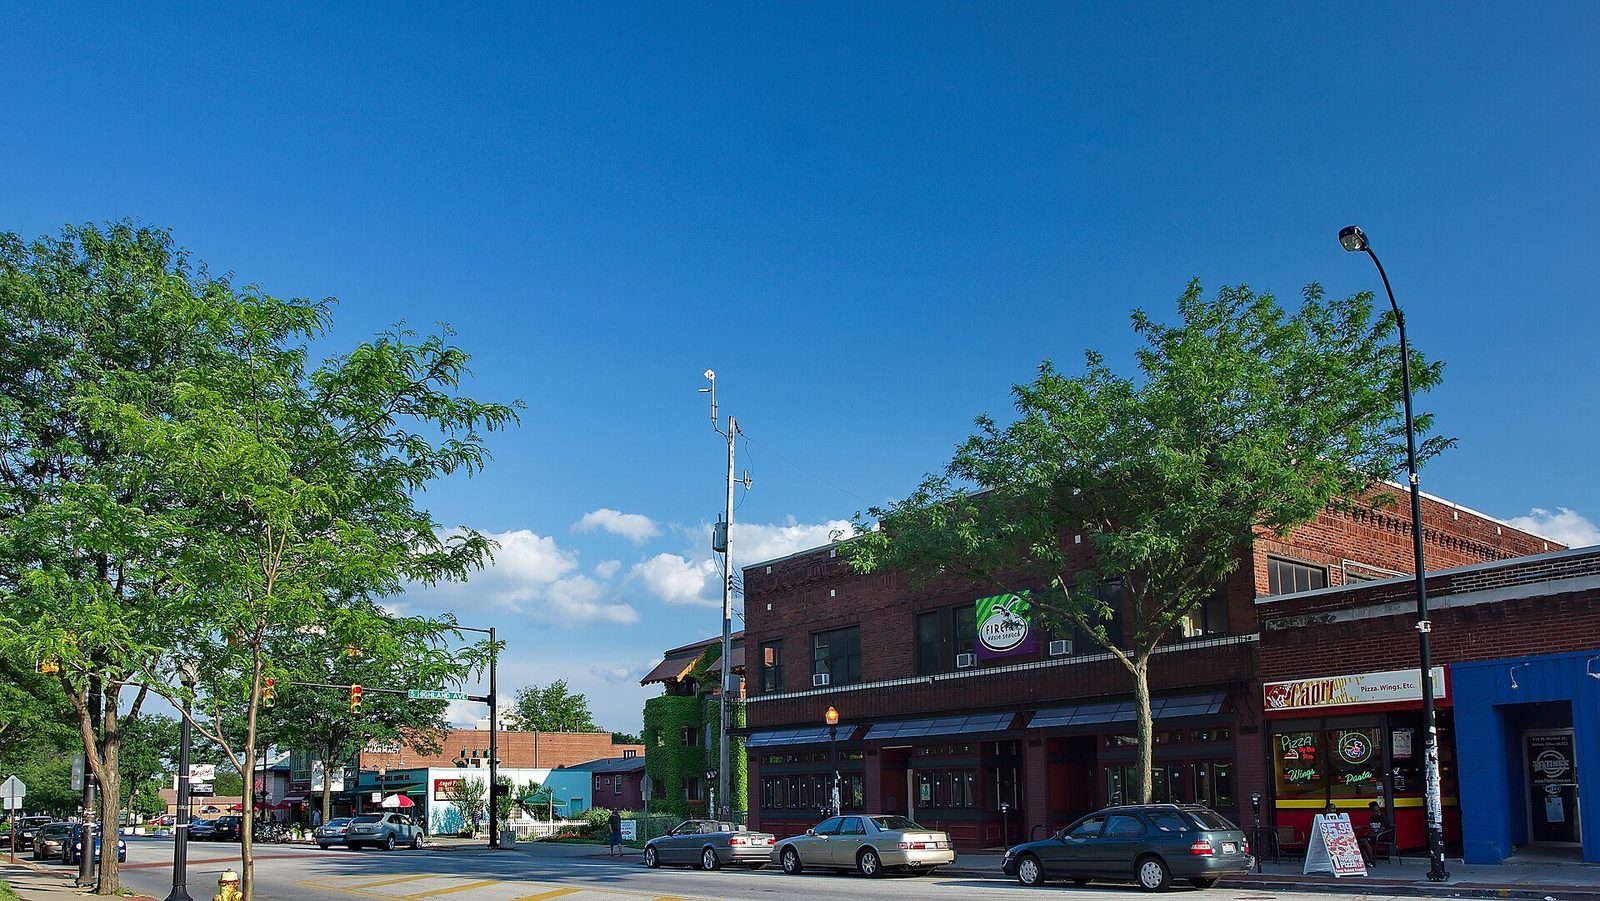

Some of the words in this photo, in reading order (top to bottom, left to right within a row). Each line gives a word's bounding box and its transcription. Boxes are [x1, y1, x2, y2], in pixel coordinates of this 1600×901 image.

[986, 621, 1022, 634] FIREF
[417, 691, 450, 699] HIGHLAND
[1288, 768, 1315, 781] Wings
[1345, 771, 1372, 785] Pasta
[1321, 822, 1351, 839] $5.99
